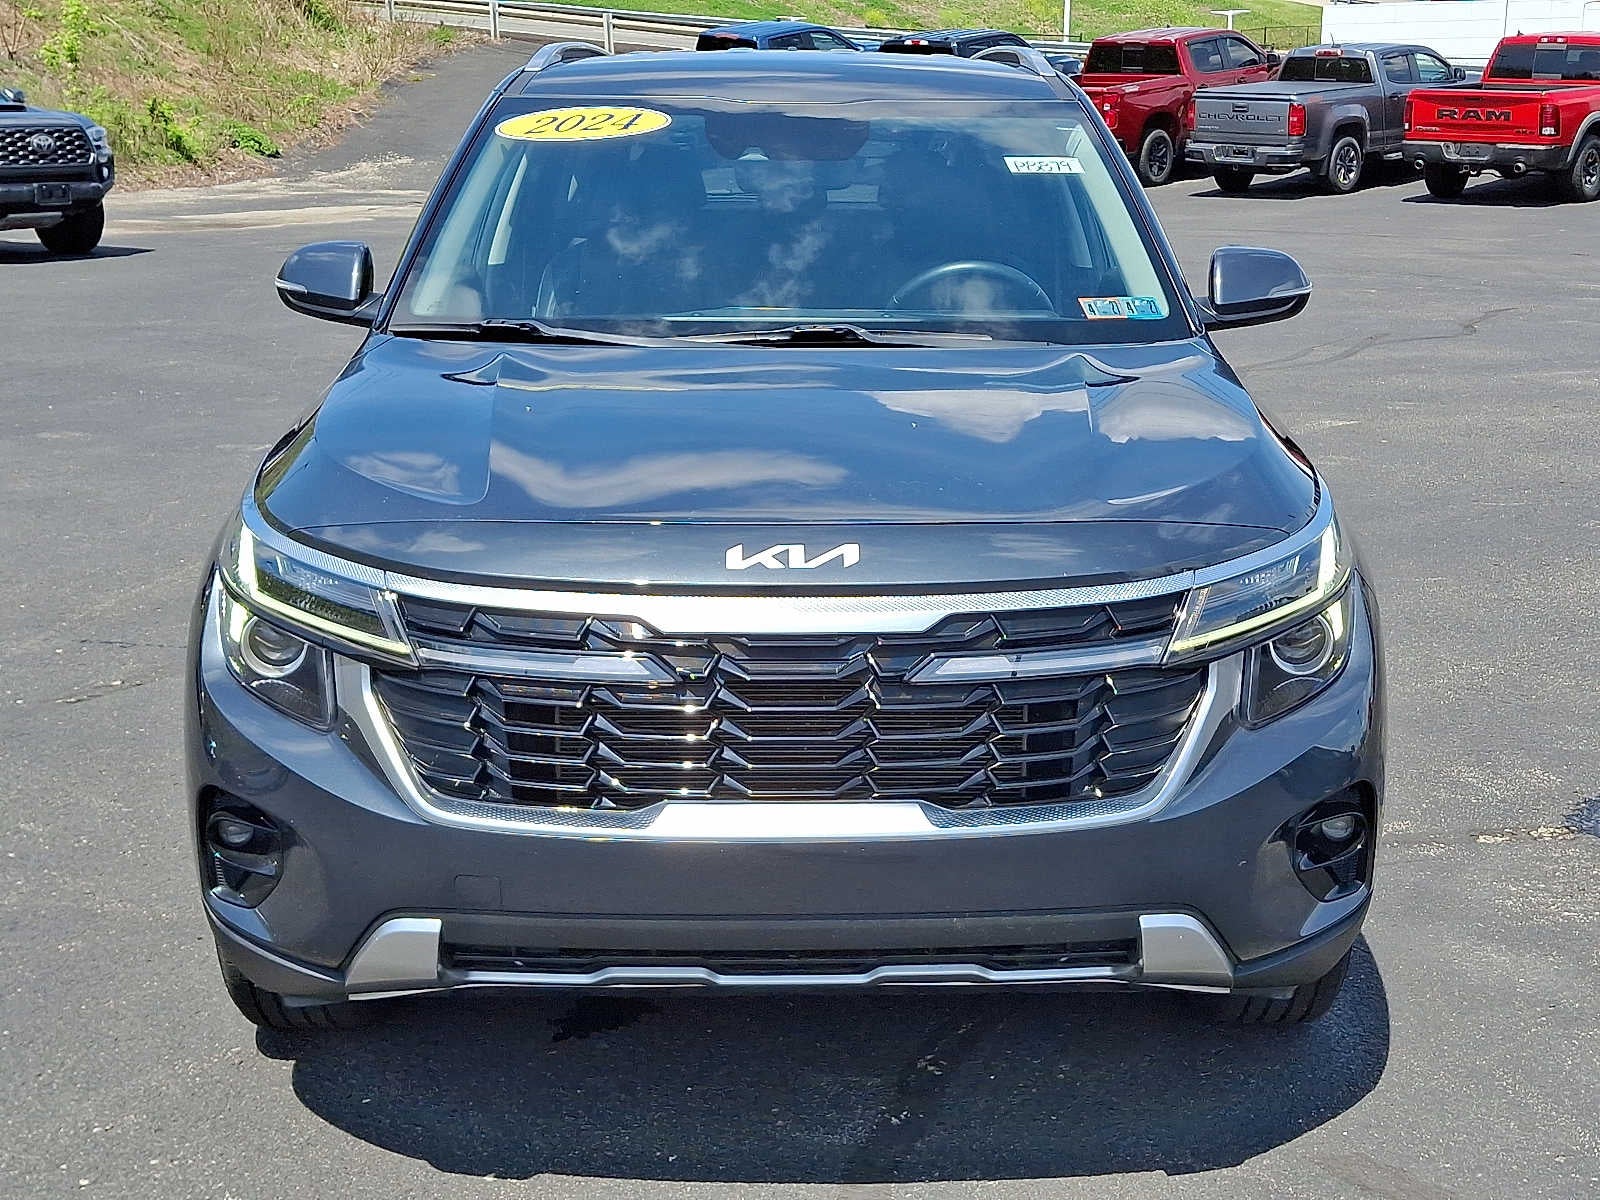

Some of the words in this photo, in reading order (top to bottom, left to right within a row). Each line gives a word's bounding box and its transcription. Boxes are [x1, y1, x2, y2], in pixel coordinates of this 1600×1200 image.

[1198, 112, 1284, 122] CHEVROLET
[1436, 108, 1512, 121] RAM
[524, 113, 643, 135] 2024
